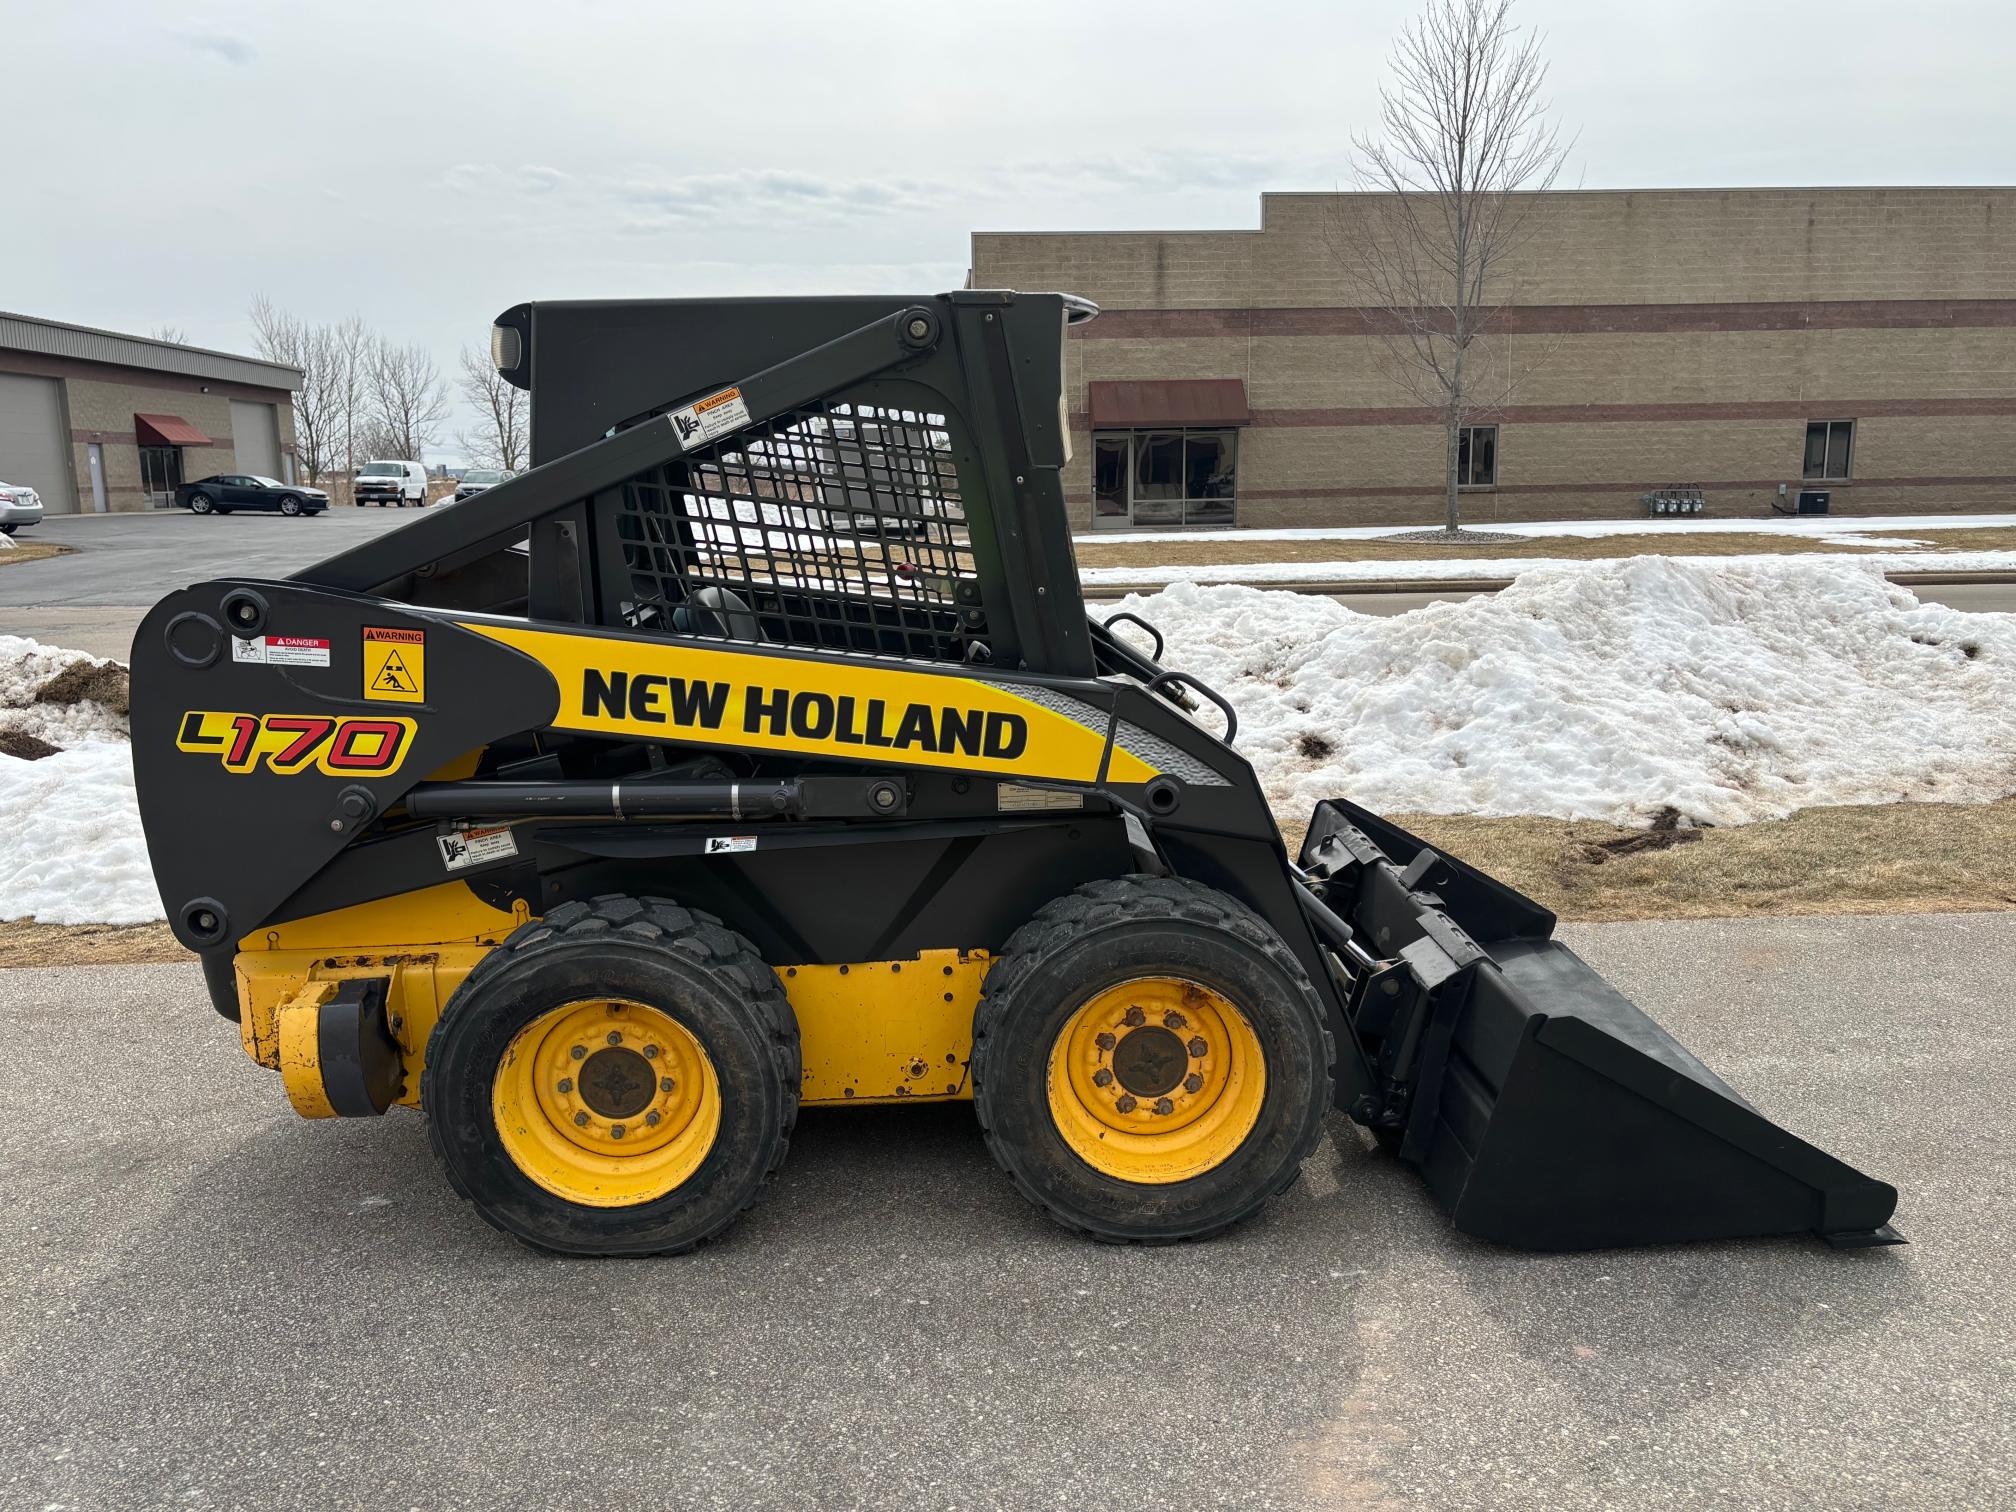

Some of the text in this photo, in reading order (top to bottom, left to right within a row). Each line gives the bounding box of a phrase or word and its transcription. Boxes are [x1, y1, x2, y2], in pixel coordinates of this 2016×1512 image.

[705, 391, 736, 408] WARNING
[706, 402, 734, 416] PINCH AREA
[285, 638, 319, 647] DANGER
[375, 630, 422, 642] WARNING
[582, 667, 1029, 760] NEW HOLLAND
[179, 712, 409, 772] L170
